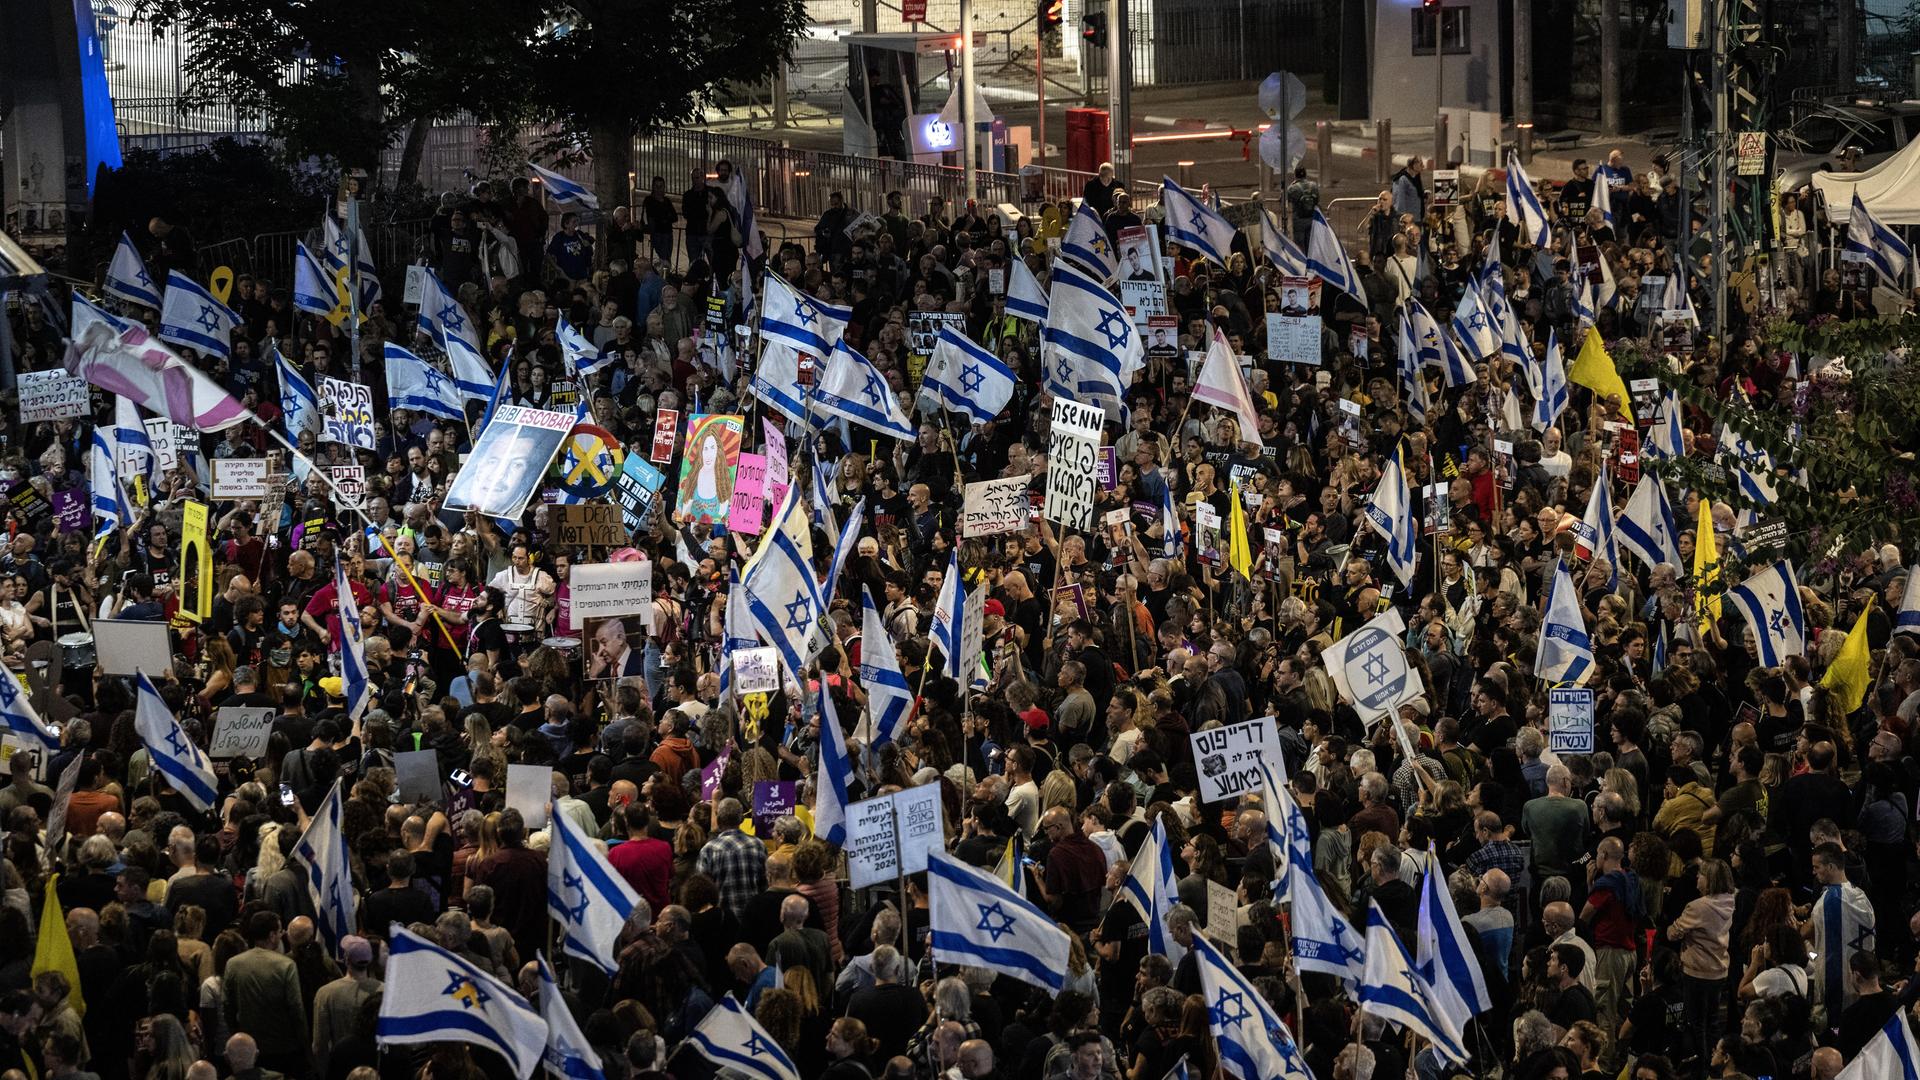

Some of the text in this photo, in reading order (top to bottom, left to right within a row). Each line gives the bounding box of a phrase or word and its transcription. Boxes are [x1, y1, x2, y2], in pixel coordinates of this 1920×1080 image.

[1122, 281, 1161, 293] בלי בחירות
[1139, 296, 1163, 307] הם לא
[495, 406, 575, 430] BIBI ESCOBAR
[1051, 401, 1102, 431] ממשלת
[1049, 431, 1096, 475] פושעים
[333, 467, 361, 478] הבוס
[619, 473, 653, 504] כמה דם
[984, 482, 1028, 497] בישראל
[1048, 464, 1093, 504] השתלטו
[620, 492, 637, 511] עוד
[1005, 494, 1029, 507] הכל
[557, 506, 620, 524] a DEAL
[967, 508, 1028, 522] חוץ מחיי אדם
[1048, 500, 1091, 531] עלינו
[967, 519, 1020, 533] די להפקיר
[557, 525, 620, 543] NOT WAR
[577, 582, 606, 592] הצוותים
[607, 582, 619, 590] את
[579, 600, 611, 609] החטופים
[613, 599, 623, 607] את
[625, 596, 649, 606] להפקיר
[1352, 634, 1378, 654] העם דורש
[1375, 685, 1396, 702] אי אמון!
[1552, 691, 1590, 702] בחירות
[222, 716, 264, 732] ממשלת
[1196, 721, 1264, 755] דרייפוס
[1554, 734, 1588, 749] עכשיו!
[1232, 752, 1242, 763] לה
[769, 785, 780, 797] لا
[764, 799, 785, 807] لحرب
[866, 801, 890, 814] החוק
[909, 800, 932, 813] דרוש
[858, 812, 891, 827] לעשיית
[907, 810, 935, 826] באופן
[880, 821, 892, 831] דין
[855, 830, 893, 846] בנתניהו
[849, 840, 895, 858] ובעוזריהם
[875, 857, 897, 871] 2024
